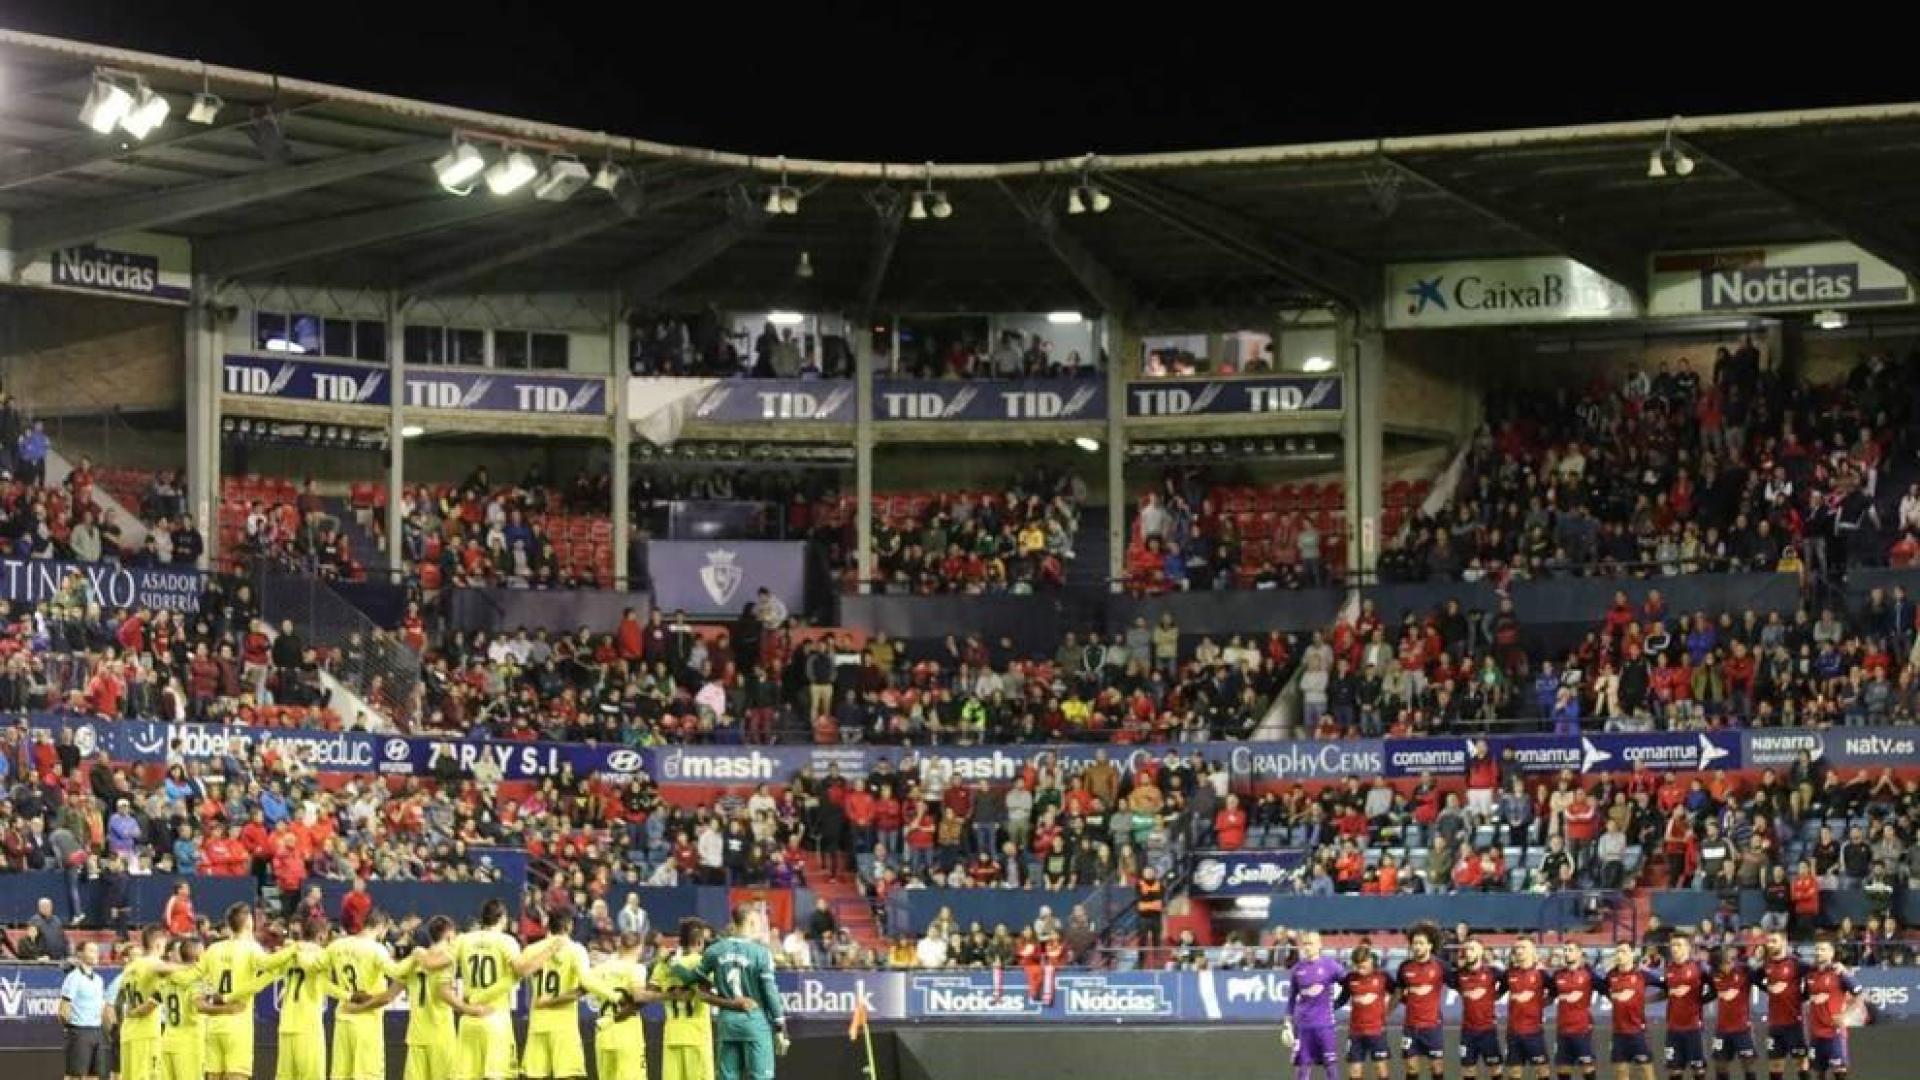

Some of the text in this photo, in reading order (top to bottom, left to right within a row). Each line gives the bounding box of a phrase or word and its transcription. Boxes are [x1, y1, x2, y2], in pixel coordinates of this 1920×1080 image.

[58, 248, 154, 291] Noticias
[1711, 266, 1851, 305] Noticias
[224, 365, 270, 394] TID
[312, 372, 358, 401] TID
[406, 379, 462, 408] TID
[514, 384, 569, 412] TID
[757, 391, 817, 419] TID
[882, 392, 944, 418] TID
[1001, 391, 1062, 418] TID
[1132, 388, 1193, 415] TID
[1244, 385, 1303, 412] TID
[3, 559, 136, 609] TINXO
[141, 572, 197, 593] ASADOR
[1515, 748, 1580, 764] omantur
[219, 969, 233, 994] 4
[468, 954, 497, 988] 10
[533, 969, 560, 1000] 19
[726, 966, 743, 1000] 1
[1070, 989, 1156, 1012] Noticias
